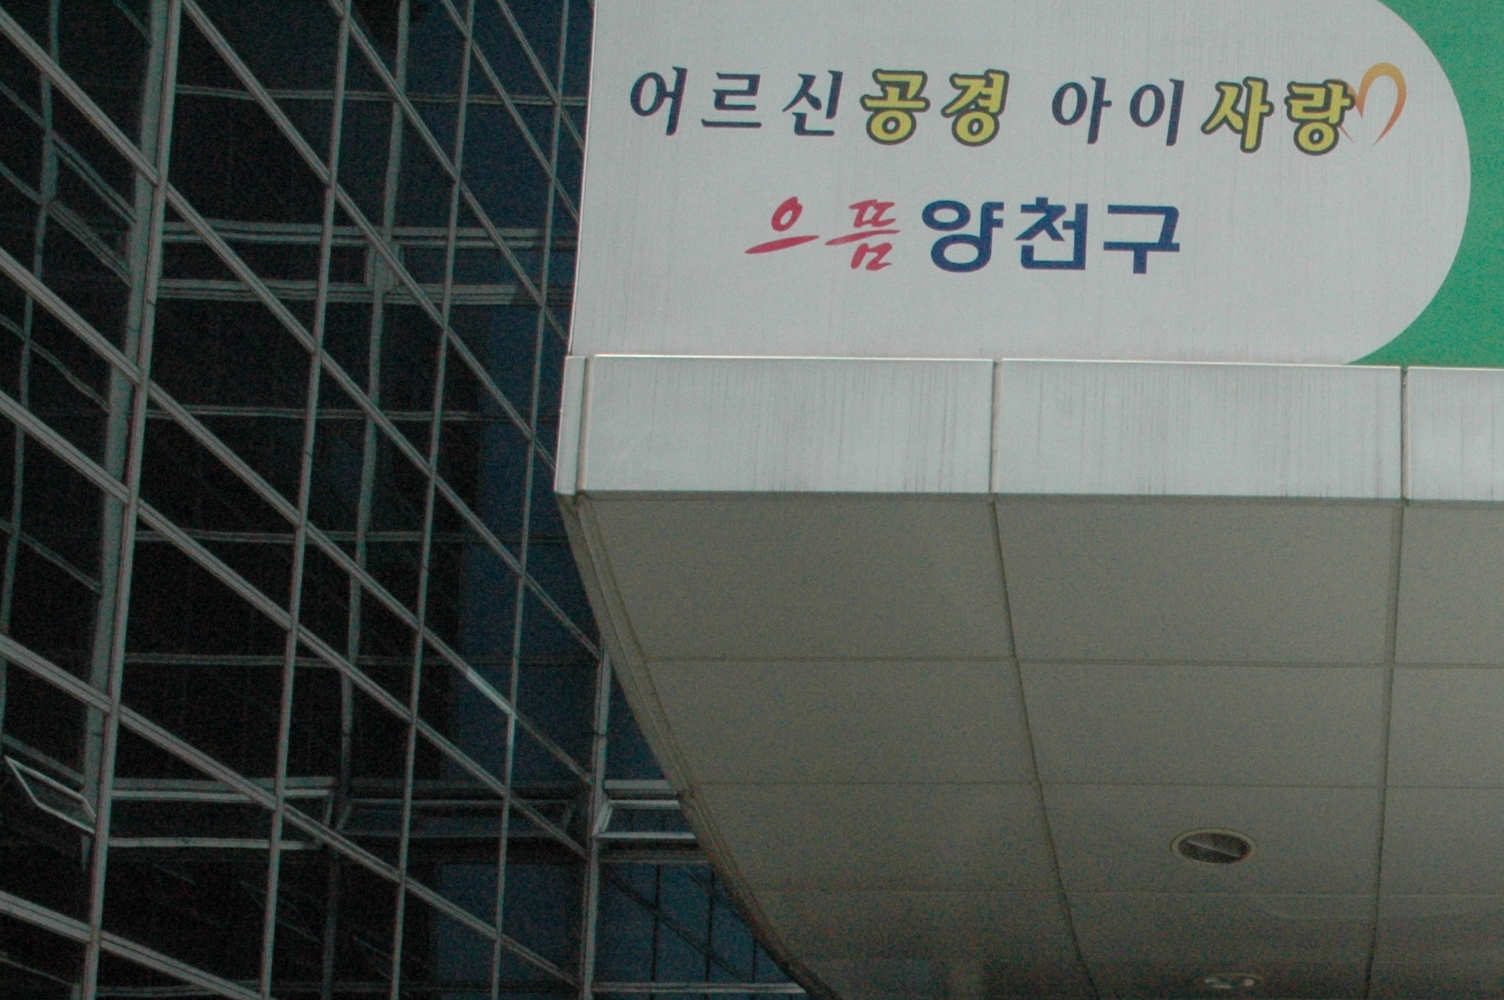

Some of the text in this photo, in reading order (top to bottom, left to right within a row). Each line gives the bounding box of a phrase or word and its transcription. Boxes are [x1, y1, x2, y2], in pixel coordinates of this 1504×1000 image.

[1051, 77, 1356, 156] 아이사랑
[745, 196, 1181, 275] 으뜸 양천구
